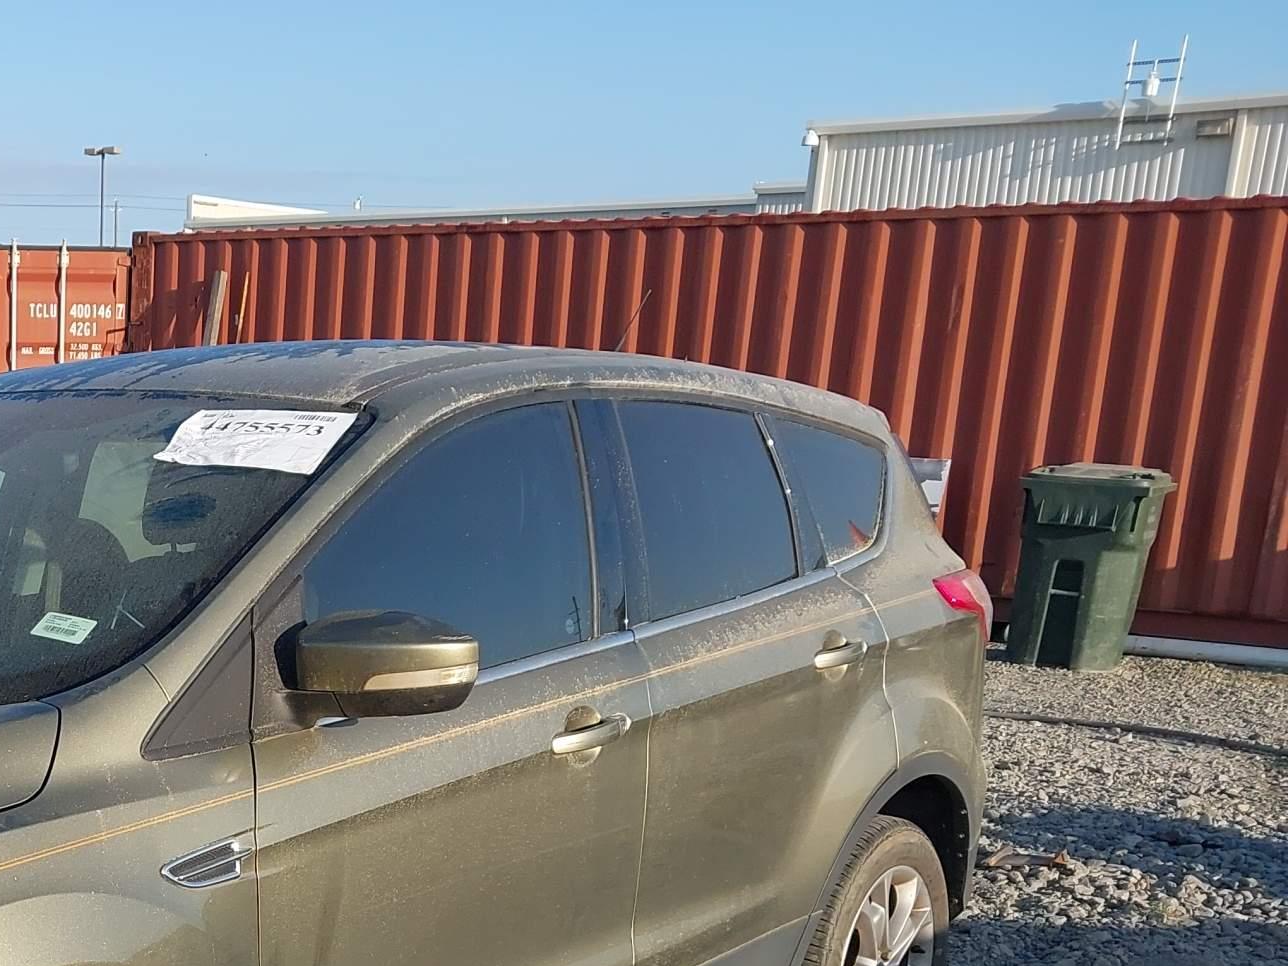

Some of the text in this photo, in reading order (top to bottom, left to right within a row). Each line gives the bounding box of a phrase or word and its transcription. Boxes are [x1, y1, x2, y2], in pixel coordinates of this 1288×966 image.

[29, 303, 58, 318] TCLU
[69, 303, 112, 319] 400146
[69, 321, 97, 337] 42G1
